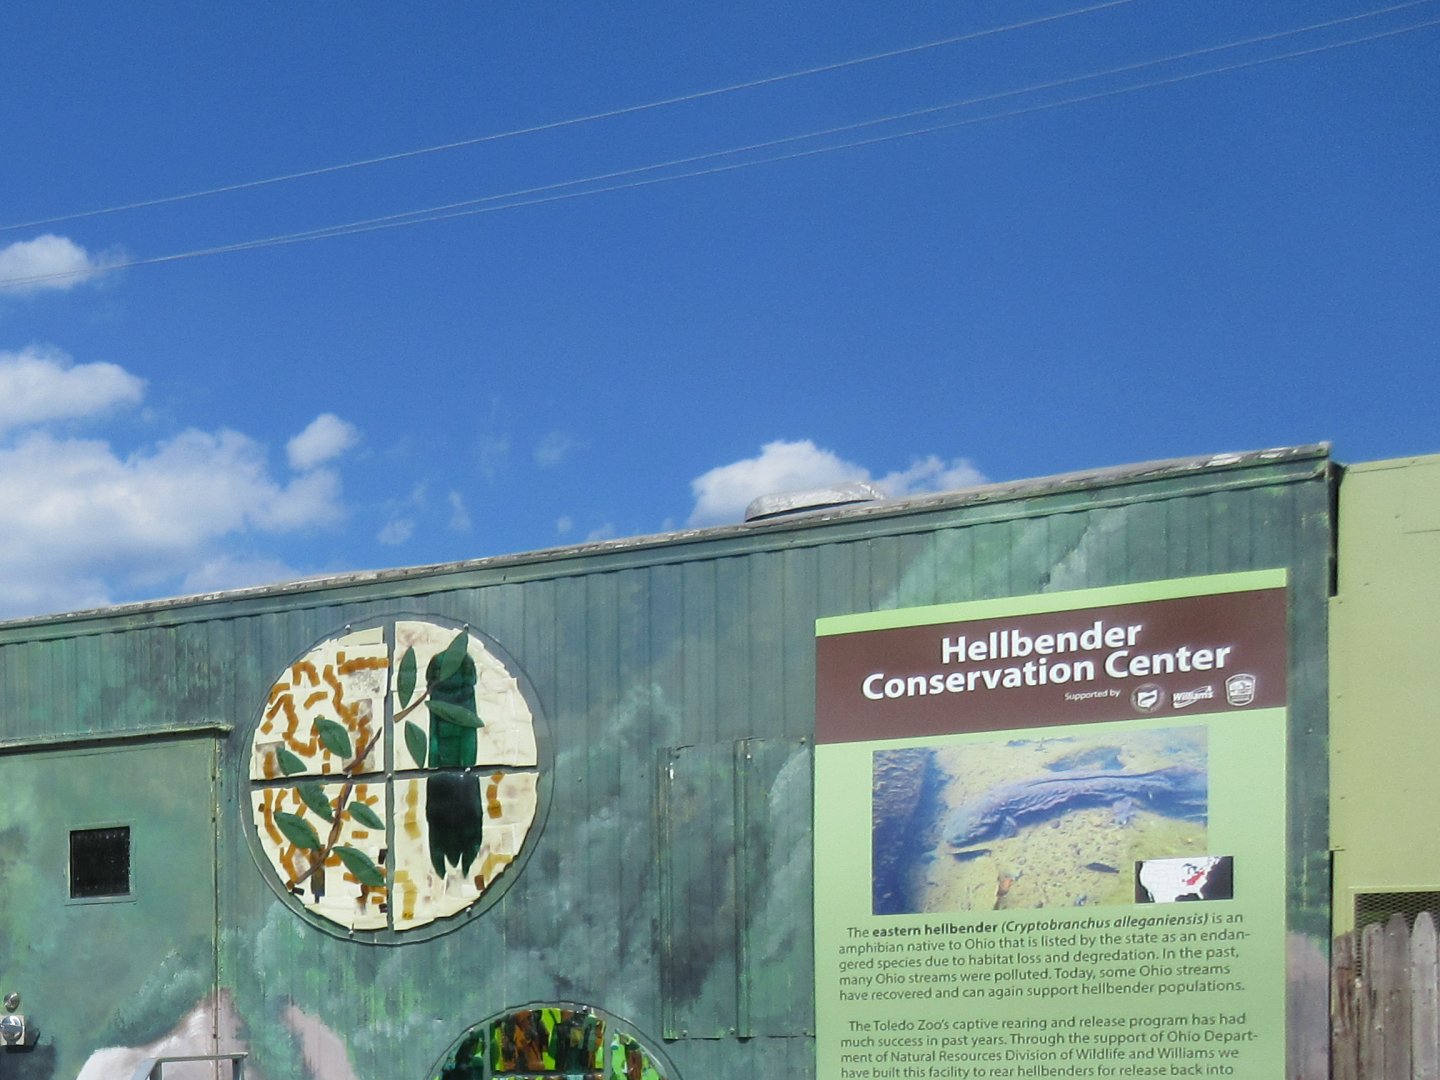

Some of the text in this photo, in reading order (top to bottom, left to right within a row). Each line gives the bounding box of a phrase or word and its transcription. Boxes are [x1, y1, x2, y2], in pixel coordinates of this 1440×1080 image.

[942, 620, 1142, 664] Hellbender
[862, 657, 1095, 700] Conservation
[1104, 646, 1231, 678] Center
[1064, 689, 1120, 701] Supported by
[847, 913, 1243, 938] The eastern hellbender (Cryptobranchus alleganiensis) is an
[839, 928, 1251, 956] amphibian native to Ohio that is listed by the state as an endan-
[838, 946, 1239, 973] gered species due to habitat loss and degredation. In the past,
[840, 965, 1231, 987] many Ohio streams were polluted. Today, some Ohio streams
[840, 980, 1245, 1001] have recovered and can again support hellbender populations.
[849, 1020, 871, 1031] The
[873, 1020, 915, 1031] Toledo
[952, 1018, 999, 1032] captive
[1002, 1018, 1047, 1031] rearing
[1051, 1016, 1075, 1028] and
[1080, 1016, 1126, 1028] release
[1129, 1016, 1188, 1029] program
[1191, 1013, 1216, 1025] has
[1219, 1012, 1246, 1025] had
[840, 1030, 1258, 1048] much success in past years. Through the support of Ohio Depart-
[840, 1047, 1239, 1063] ment of Natural Resources Division of Wildlife and Williams we
[841, 1063, 1234, 1080] have built this facility to rear hellbenders for release back into
